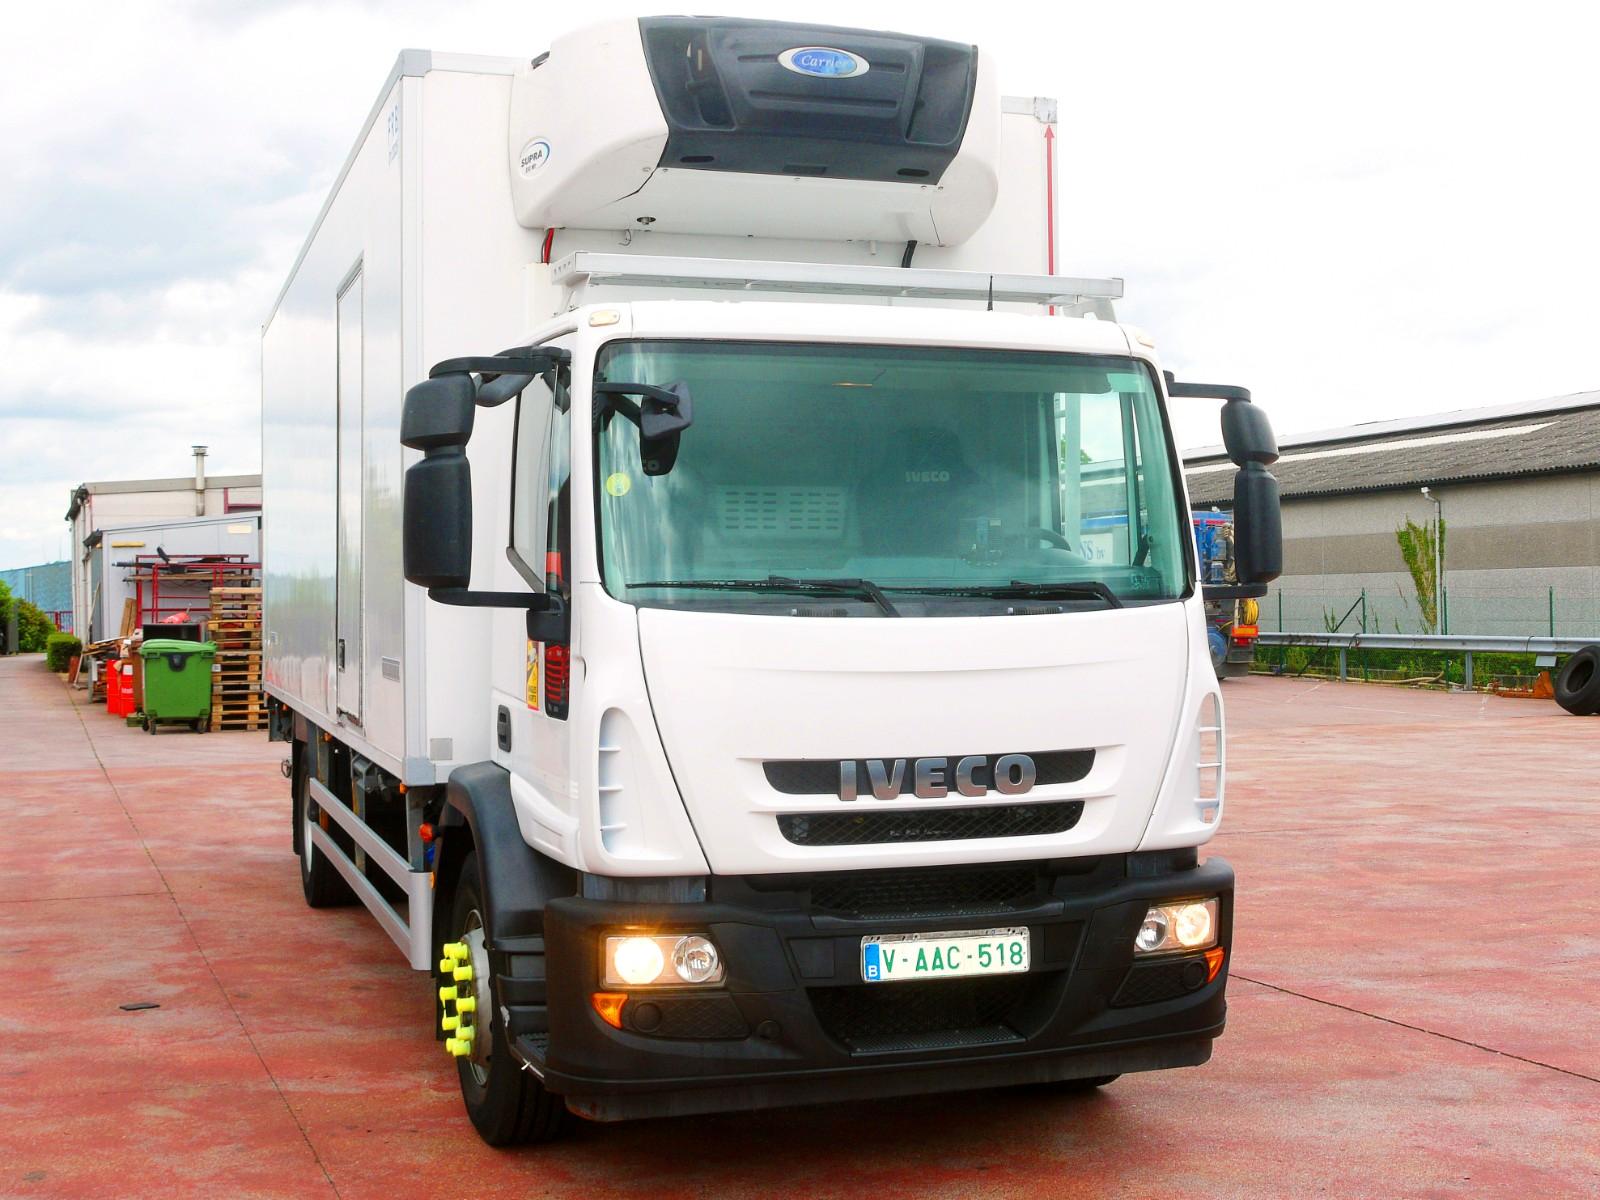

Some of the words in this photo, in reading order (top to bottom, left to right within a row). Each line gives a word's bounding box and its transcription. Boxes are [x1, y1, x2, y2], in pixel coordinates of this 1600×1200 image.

[521, 149, 543, 168] SUPRA
[904, 470, 950, 483] IVECO
[838, 754, 1037, 801] IVECO
[868, 965, 878, 977] B
[882, 941, 1024, 974] V-AAC-518
